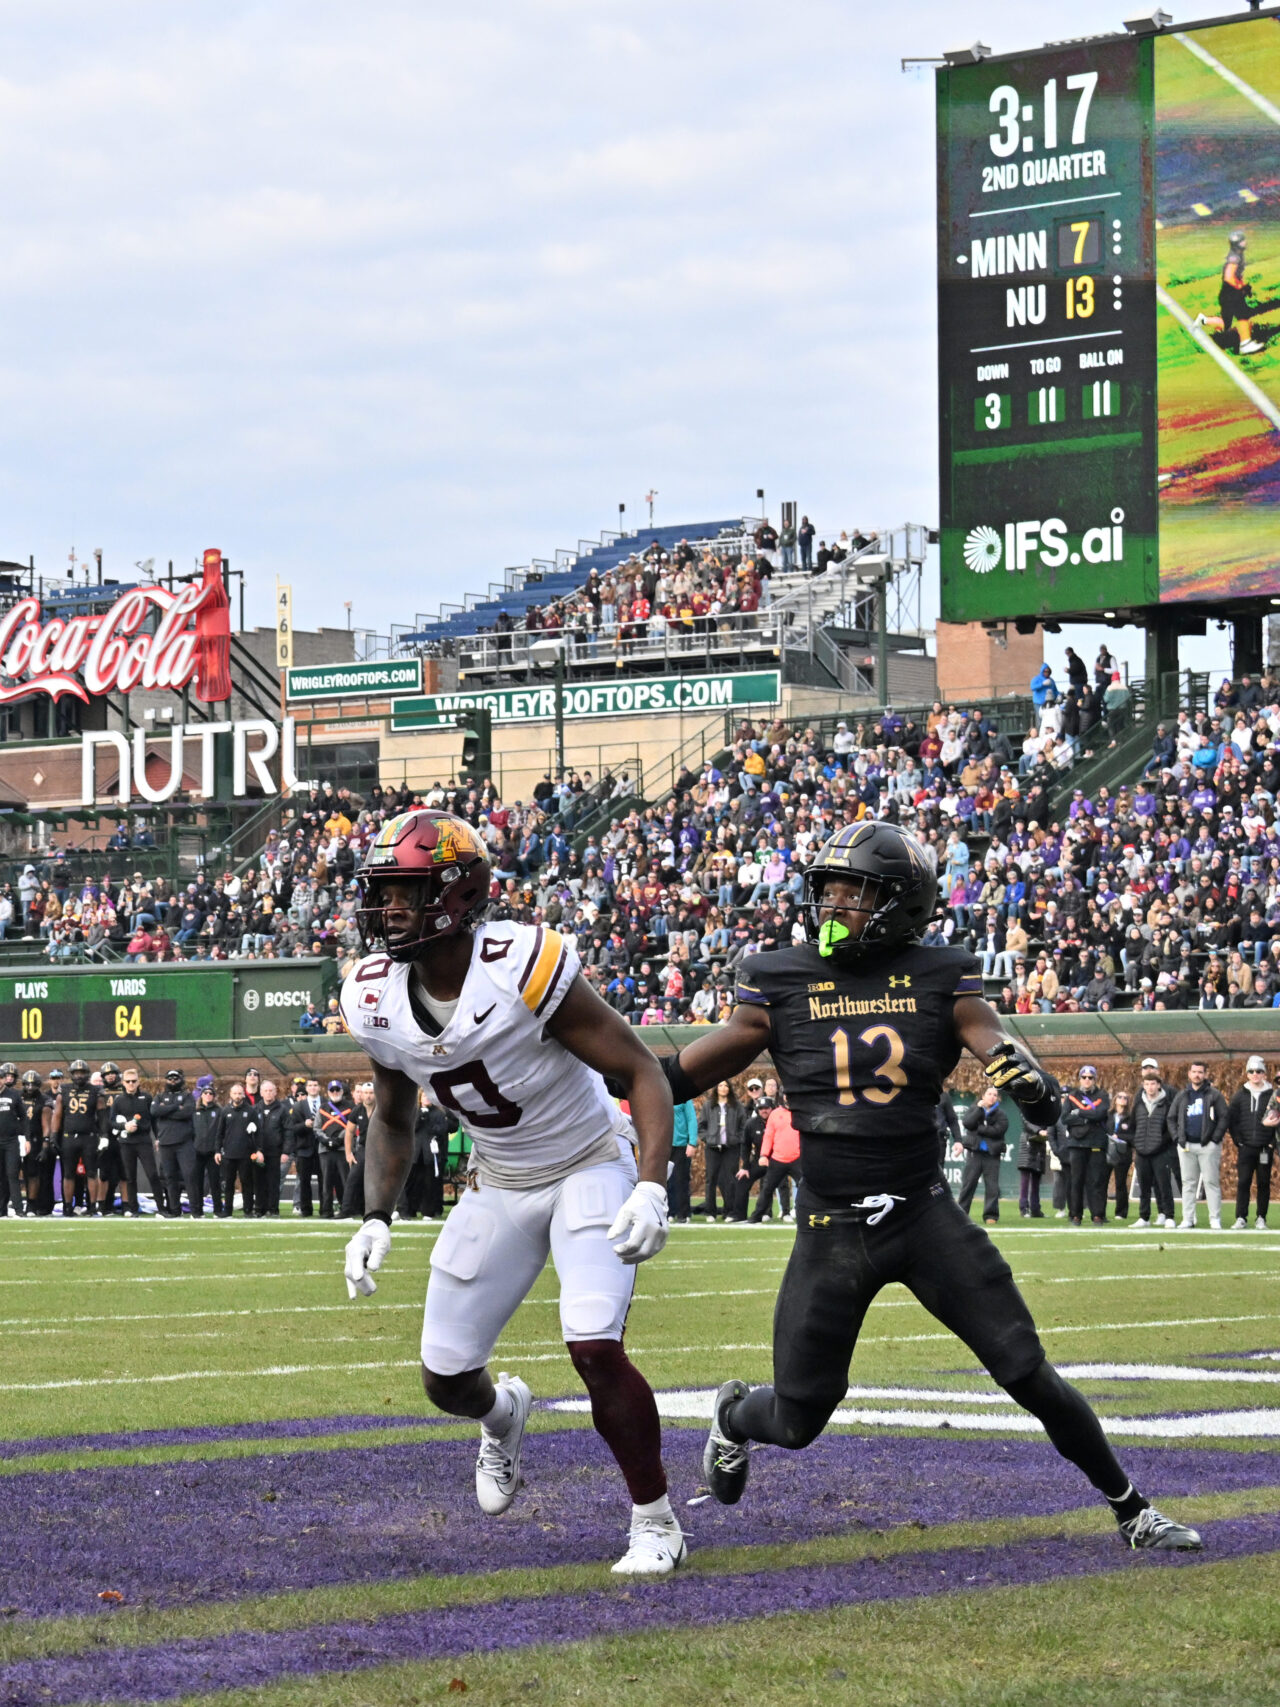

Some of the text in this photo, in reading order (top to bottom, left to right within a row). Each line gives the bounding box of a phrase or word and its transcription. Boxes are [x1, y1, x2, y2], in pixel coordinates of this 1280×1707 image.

[989, 71, 1099, 158] 3:17
[981, 150, 1106, 193] 2ND QUARTER
[971, 221, 1089, 279] MINN 7
[1006, 275, 1095, 328] NU 13
[977, 348, 1123, 381] DOWN TO GO BALL ON
[984, 380, 1111, 430] 3 11 11
[1005, 507, 1124, 572] IFS.ai
[291, 667, 416, 691] WRIGLEYROOFTOPS.COM
[15, 981, 49, 999] PLAYS
[110, 978, 147, 997] YARDS
[264, 990, 311, 1008] BOSCH
[114, 1004, 144, 1039] 64
[808, 992, 917, 1021] Northwestern
[21, 1008, 43, 1041] 10
[830, 1026, 908, 1106] 13
[69, 1097, 88, 1114] 95
[429, 1059, 523, 1128] 0
